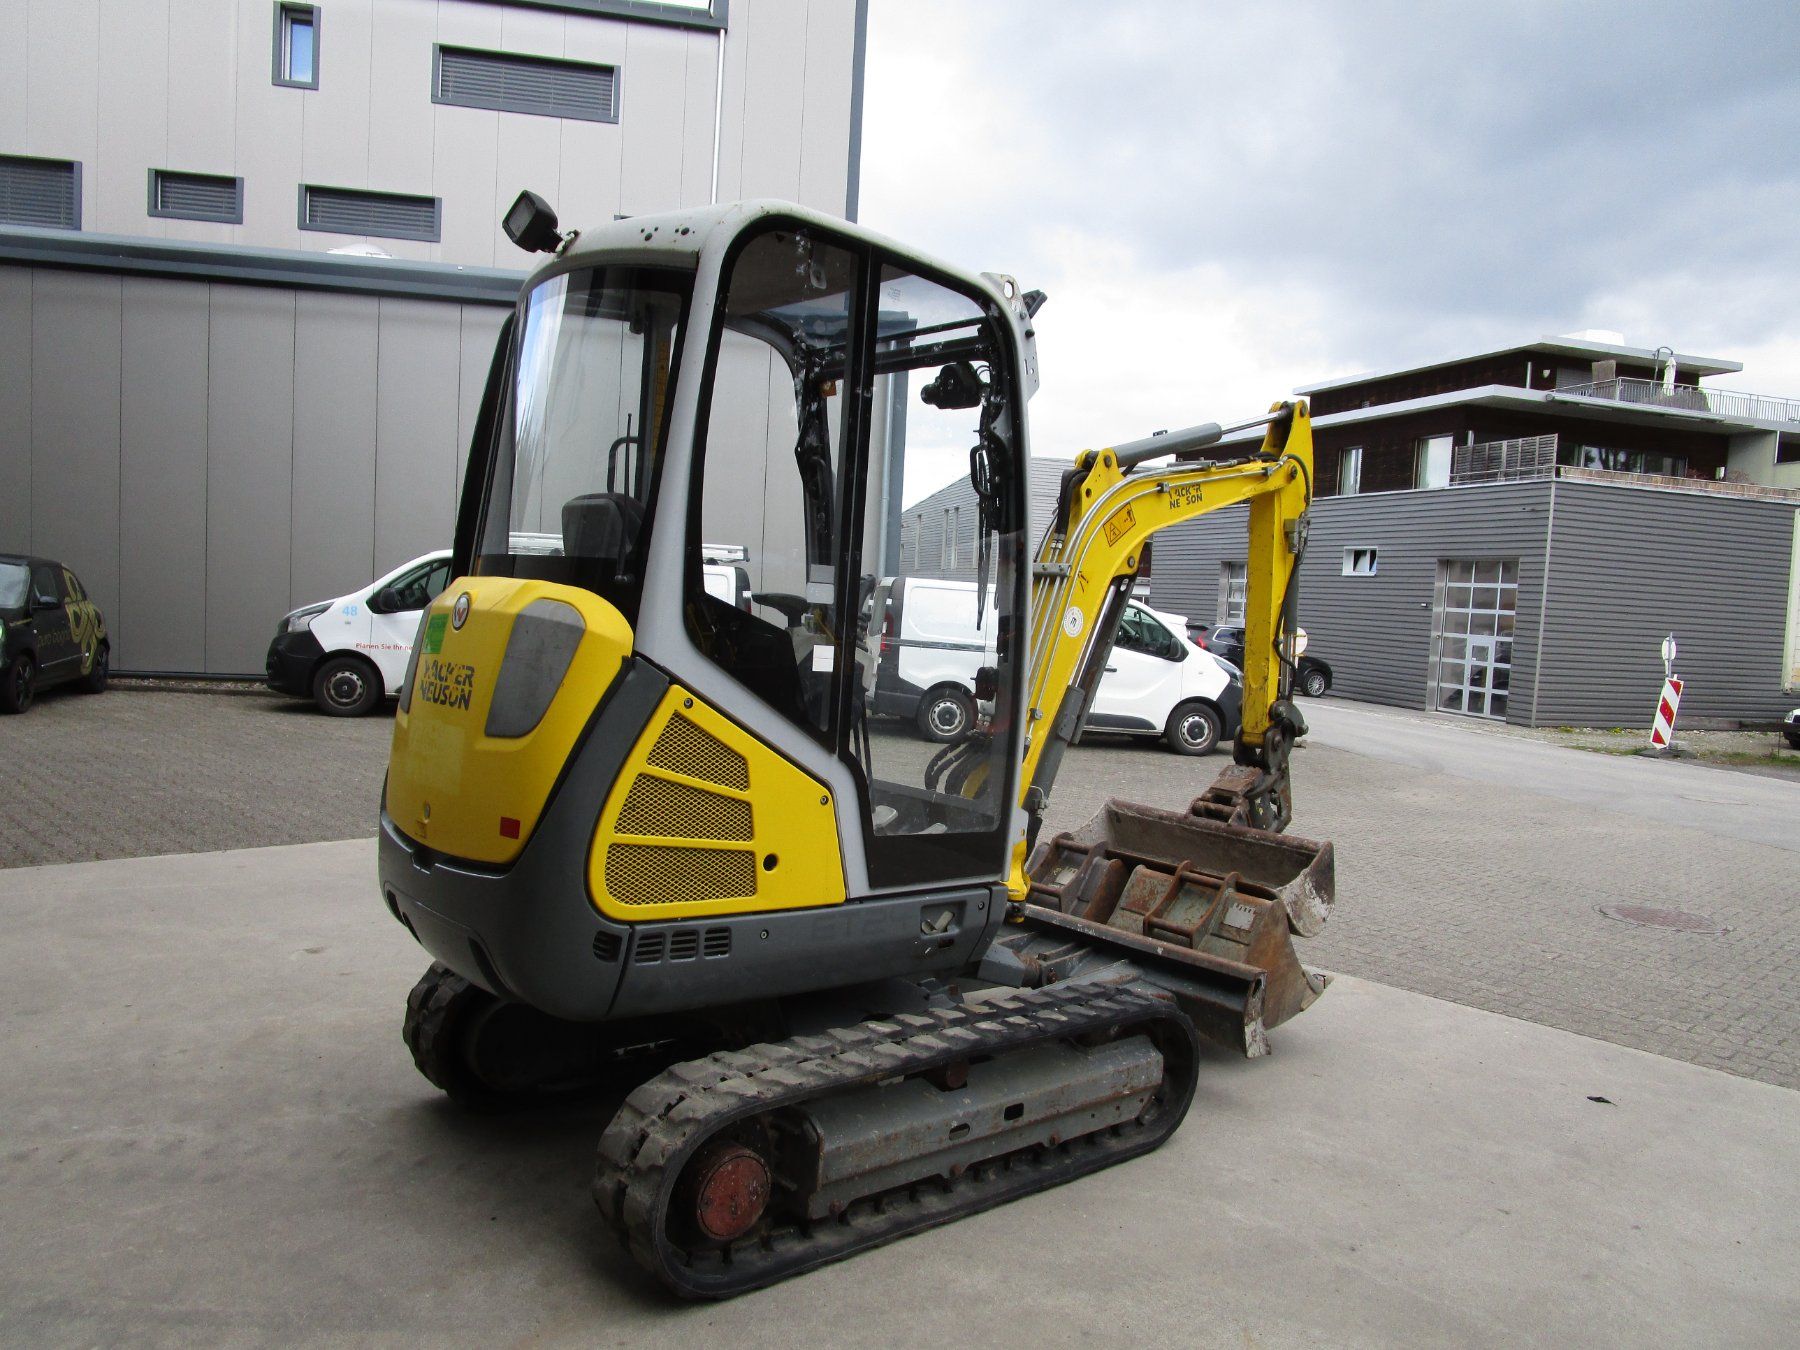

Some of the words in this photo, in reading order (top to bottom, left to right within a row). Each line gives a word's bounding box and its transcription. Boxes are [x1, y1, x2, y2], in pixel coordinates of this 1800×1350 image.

[342, 606, 358, 617] 48
[356, 642, 379, 651] Planen
[381, 643, 391, 651] Sie
